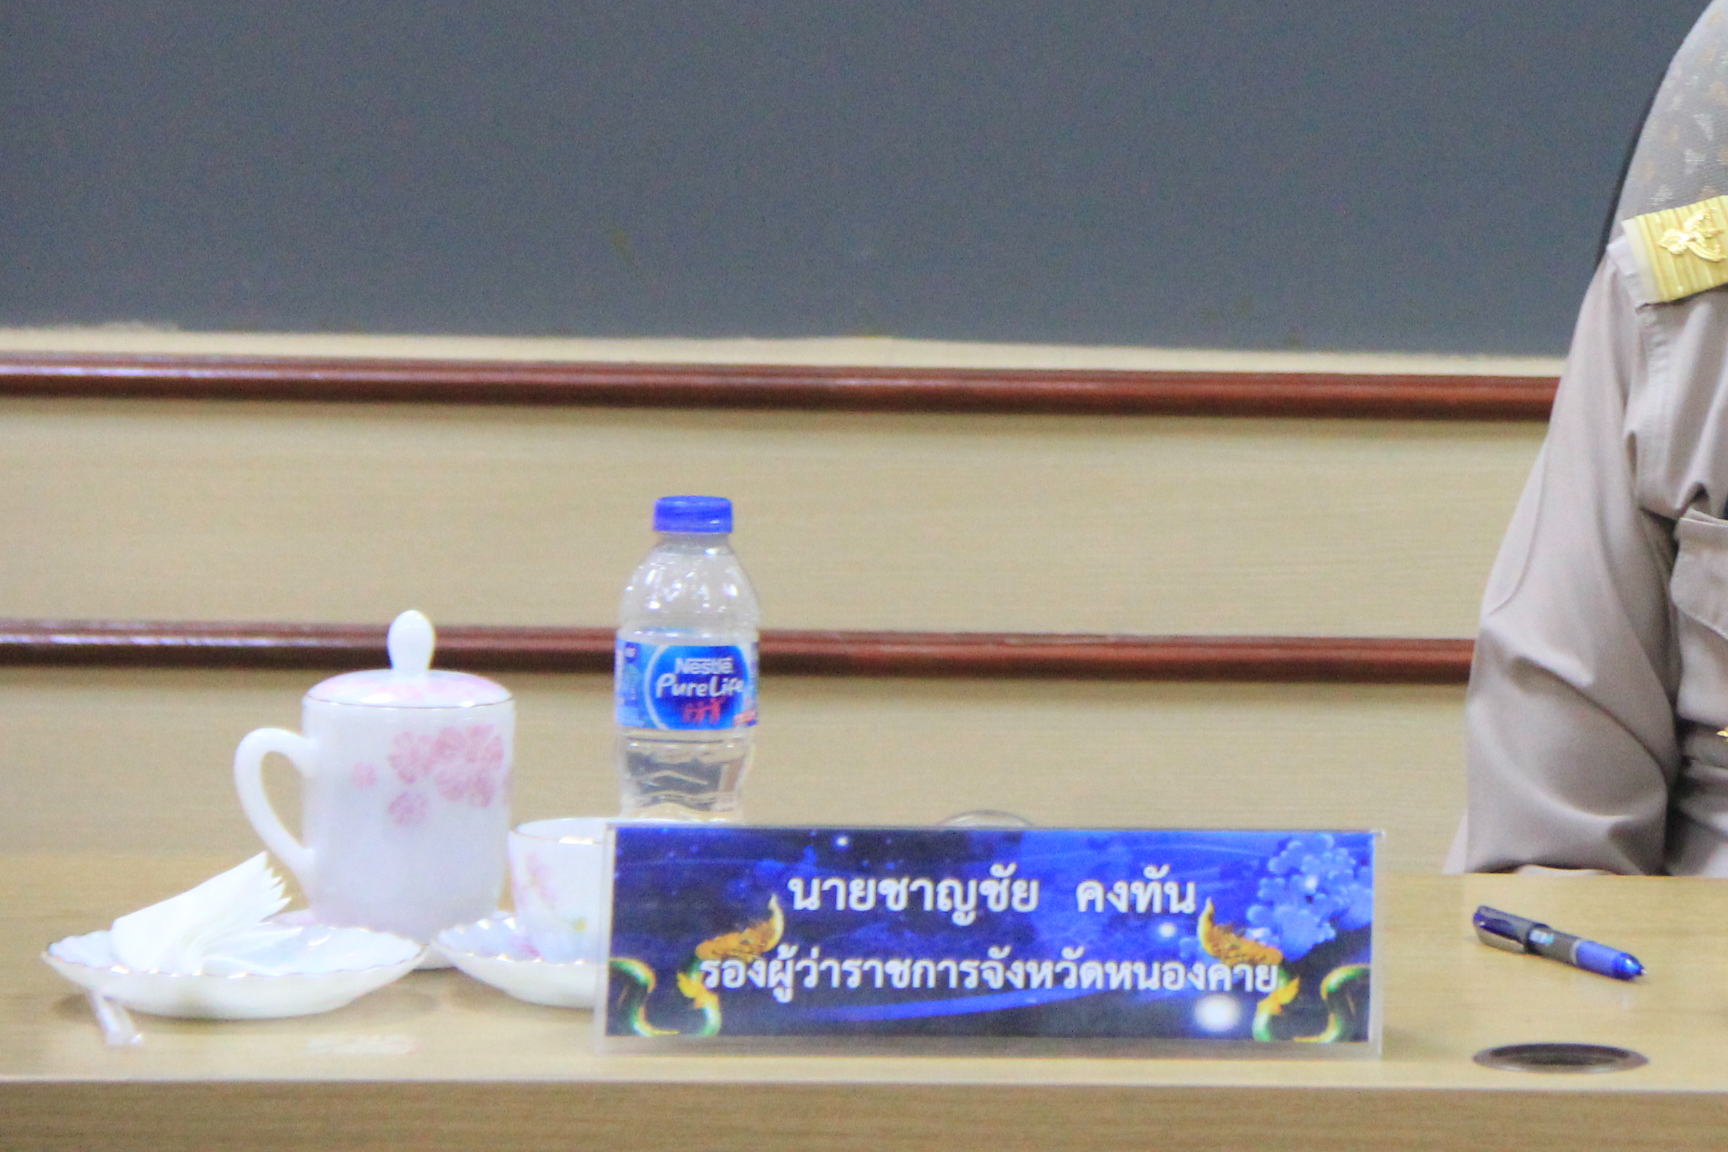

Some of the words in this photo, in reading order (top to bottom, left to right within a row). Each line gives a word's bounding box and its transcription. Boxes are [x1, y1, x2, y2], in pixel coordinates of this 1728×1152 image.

[657, 674, 708, 697] Pure
[708, 675, 745, 698] Life
[787, 862, 1041, 927] นายชาญชัย
[1076, 863, 1197, 914] คงทัน
[699, 942, 1280, 1005] รองผู้ว่าราชการจังหวัดหนองคาย
